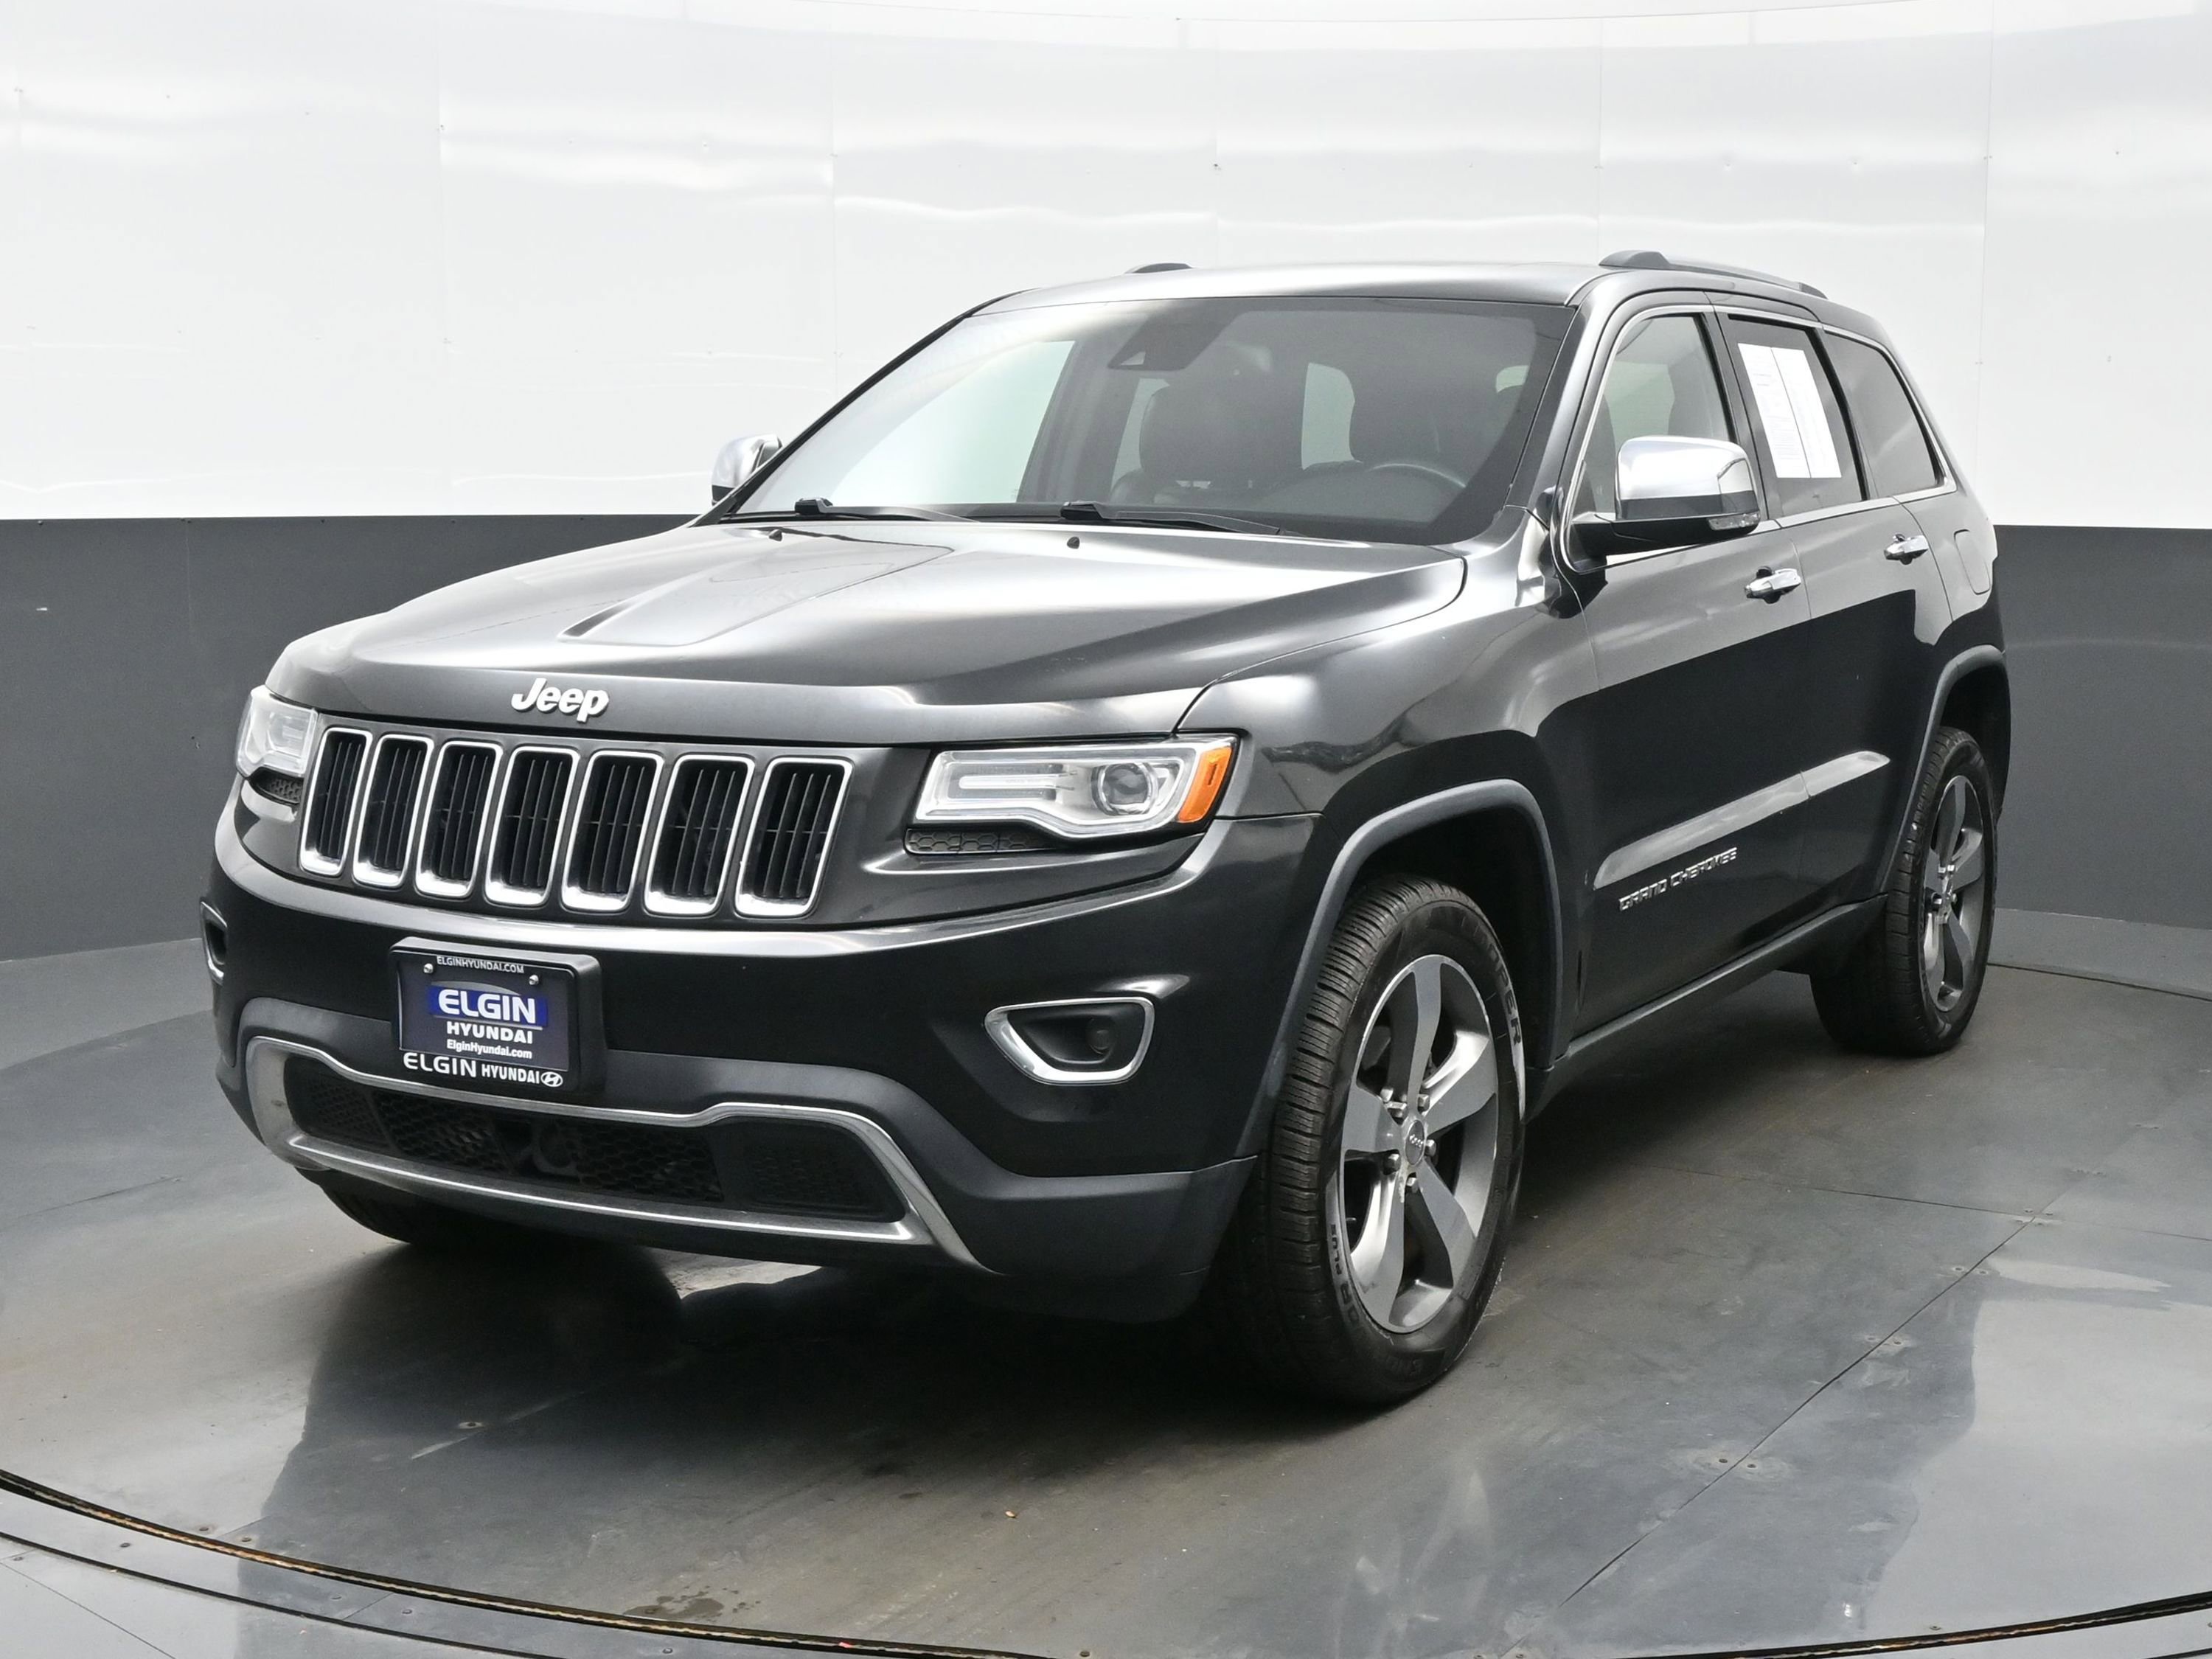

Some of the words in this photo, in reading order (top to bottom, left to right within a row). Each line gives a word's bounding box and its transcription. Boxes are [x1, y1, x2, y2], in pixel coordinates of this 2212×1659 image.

[511, 678, 609, 723] Jeep
[1618, 878, 1667, 911] GRAND
[1669, 846, 1737, 887] CHEROKEE
[437, 956, 524, 973] ELGINHYUNDAI.COM
[438, 989, 536, 1023] ELGIN
[446, 1021, 532, 1044] HYUNDAI
[446, 1039, 532, 1059] ElginHyundai.com
[403, 1052, 476, 1077] ELGIN
[481, 1065, 540, 1084] HYUNDAI
